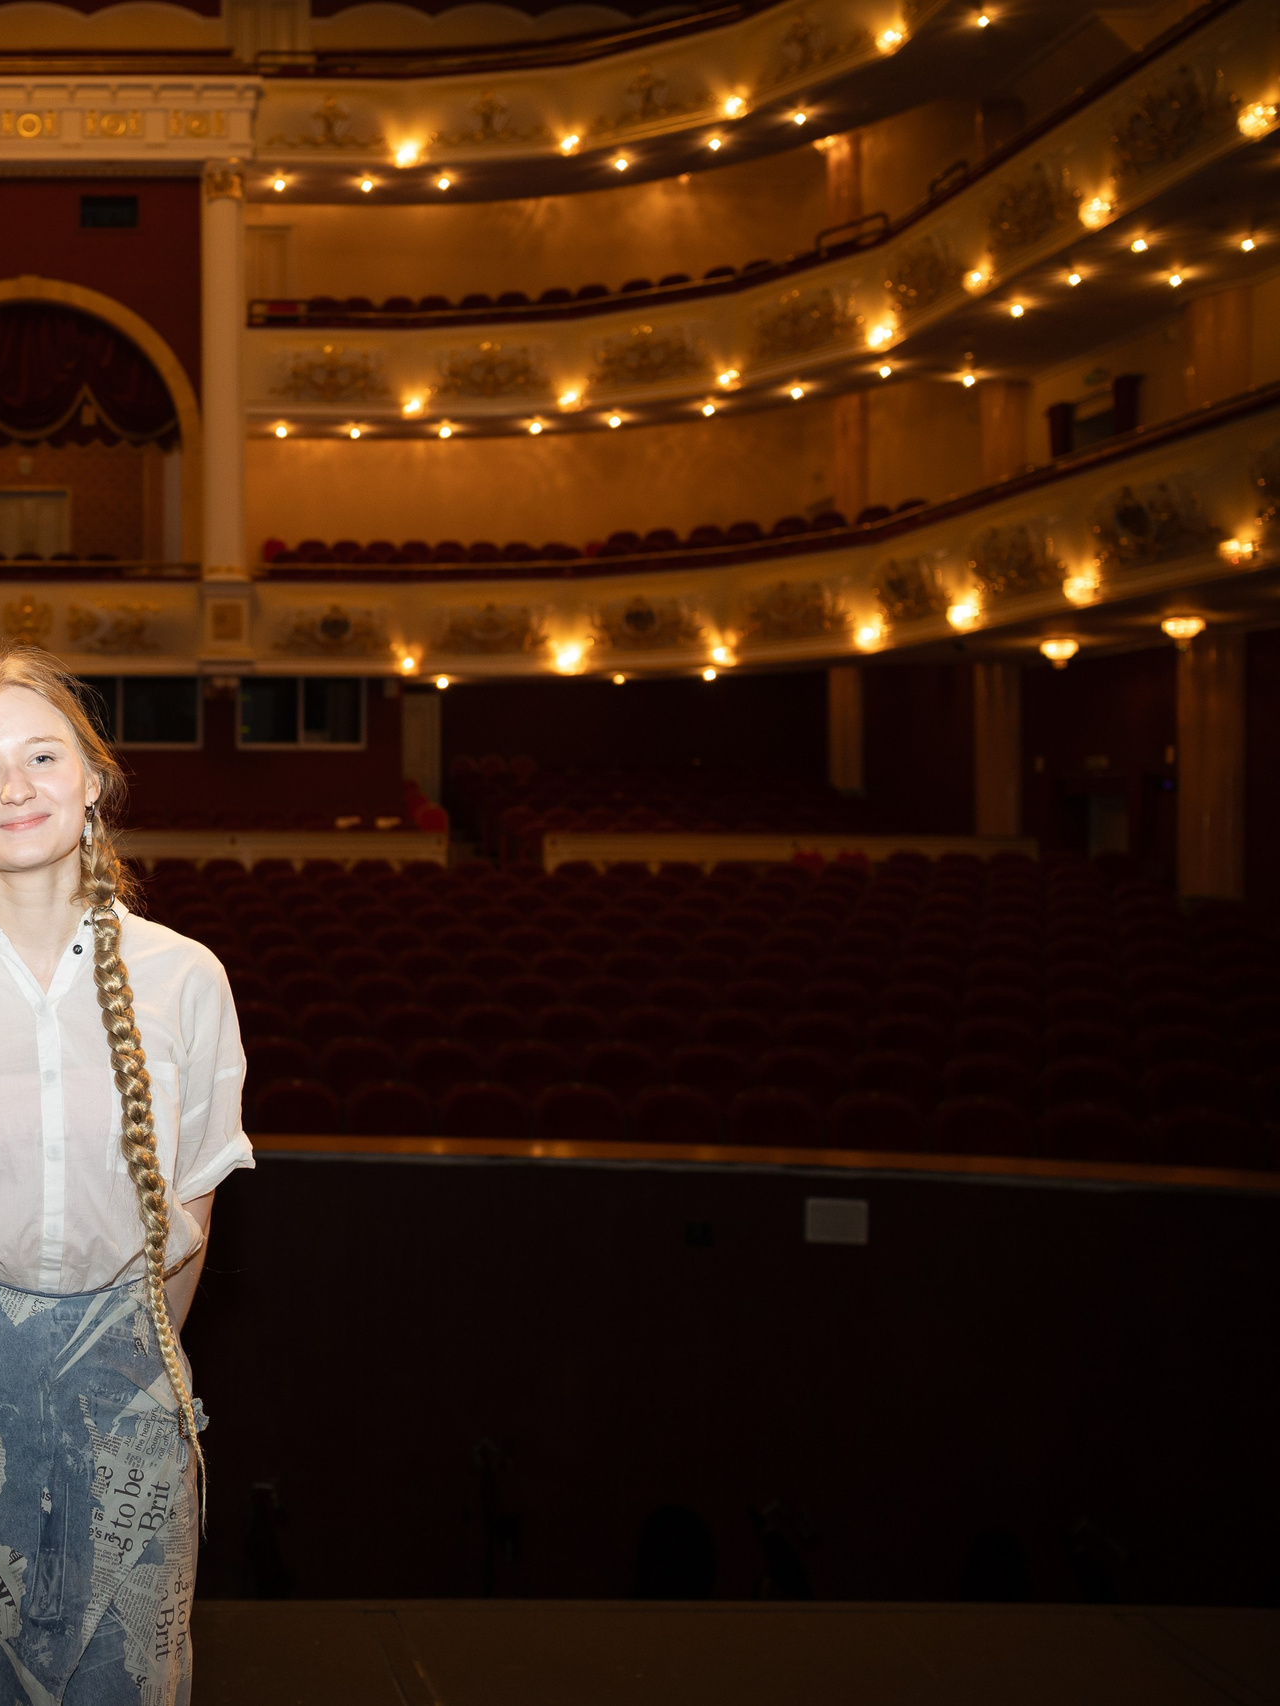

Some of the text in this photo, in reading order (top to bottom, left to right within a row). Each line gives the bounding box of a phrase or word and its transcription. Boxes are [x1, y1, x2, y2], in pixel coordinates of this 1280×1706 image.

[114, 1468, 145, 1499] be
[110, 1503, 136, 1529] to
[137, 1480, 171, 1532] Brit
[155, 1604, 175, 1662] Brit
